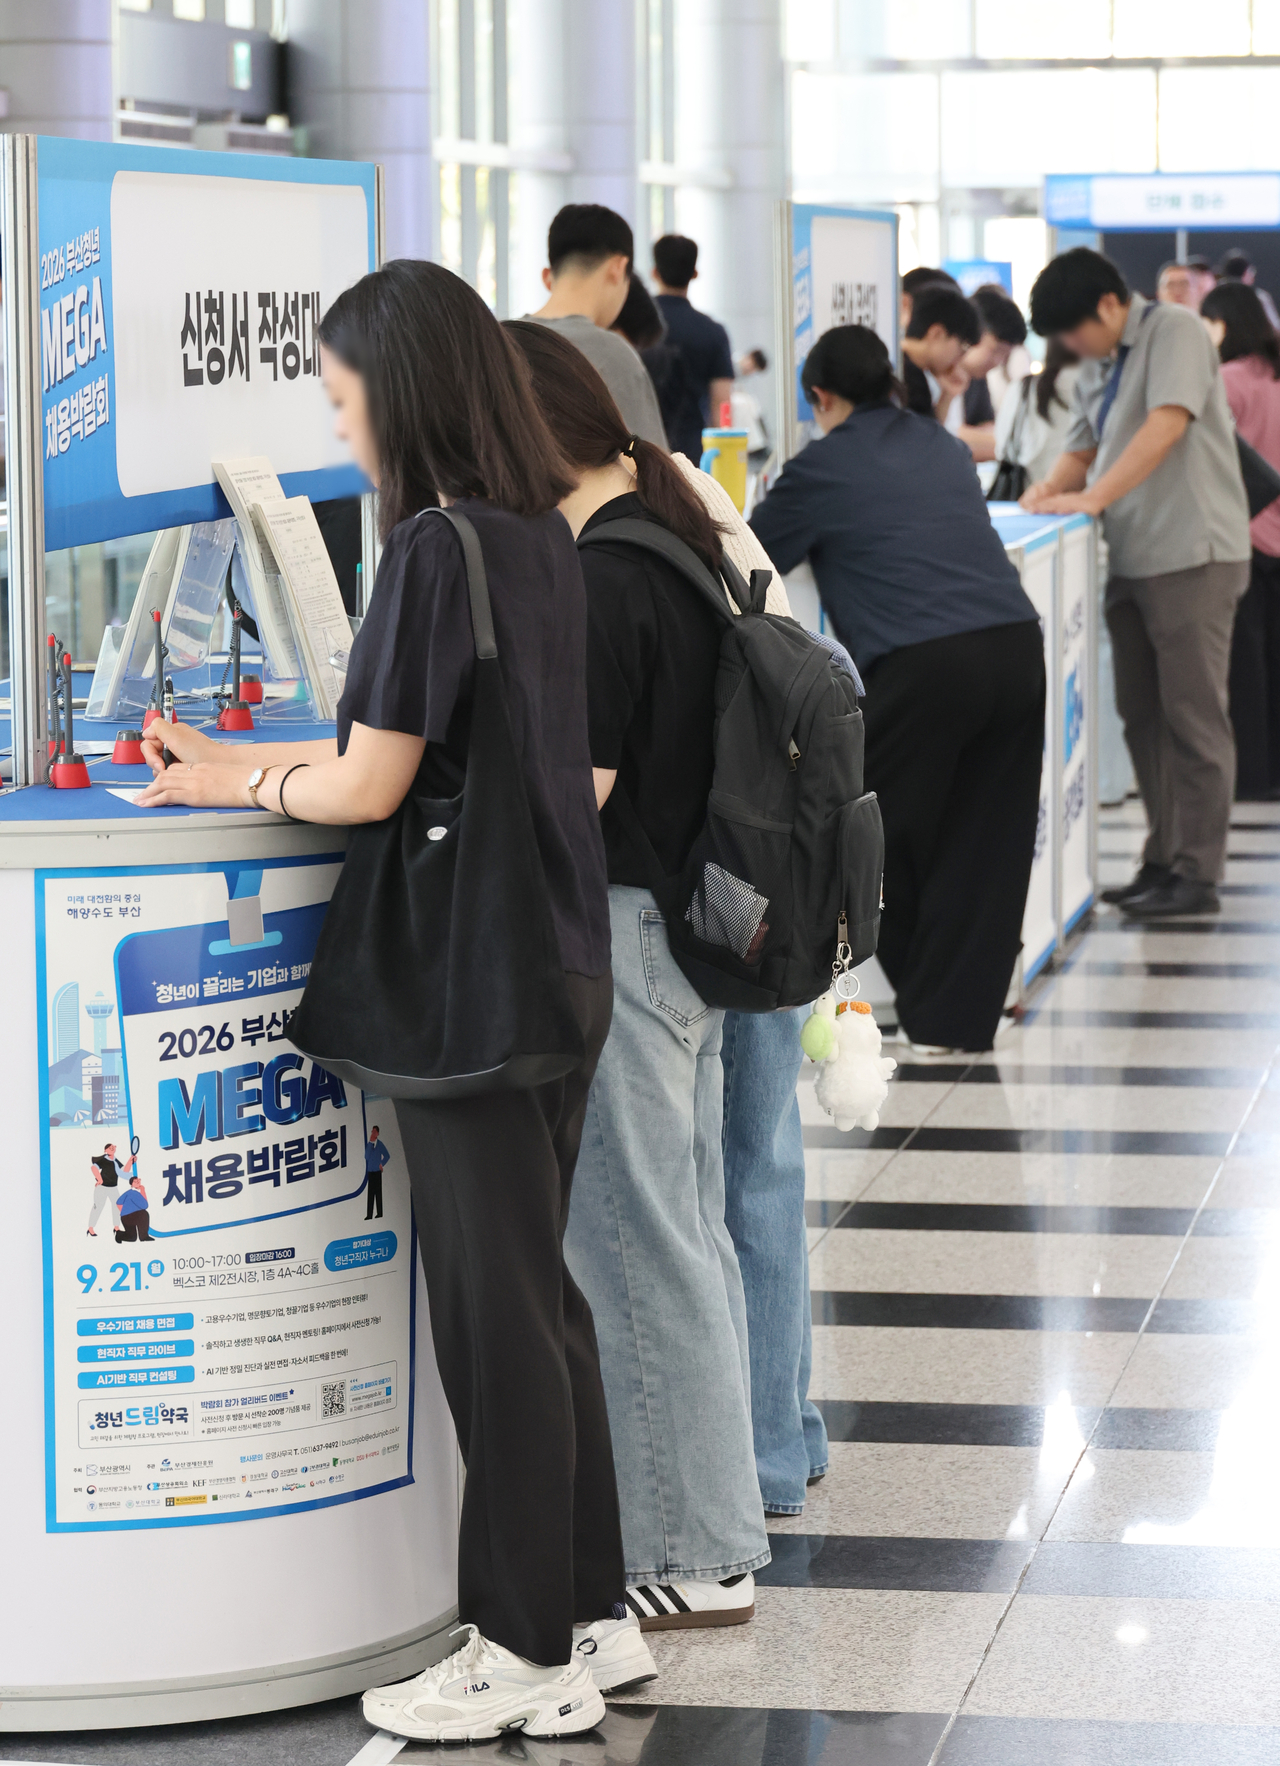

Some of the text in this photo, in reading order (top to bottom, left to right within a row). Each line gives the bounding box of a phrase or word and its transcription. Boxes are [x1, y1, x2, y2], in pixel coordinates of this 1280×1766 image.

[41, 226, 101, 290] 2026 부산청년
[41, 275, 107, 393] MEGA
[181, 289, 321, 387] 신청서 작성대
[45, 373, 109, 460] 채용박람회
[67, 893, 140, 904] 미래 대전환의 중심
[67, 906, 141, 919] 해양수도 부산
[156, 983, 199, 1004] 청년이
[203, 976, 244, 997] 끌리는
[247, 966, 288, 989] 기업과
[158, 1022, 235, 1062] 2026
[158, 1053, 348, 1150] MEGA
[162, 1124, 347, 1207] 채용박람회
[173, 1253, 242, 1270] 10:00~17:00
[249, 1249, 292, 1263] 입장마감 16:00
[334, 1246, 389, 1267] 청년구직자 누구나
[76, 1262, 162, 1293] 9. 21. 월
[173, 1262, 319, 1289] 벡스코 제2전시장, 1층 4A~4C홀
[96, 1317, 175, 1332] 우수기업 채용 면접
[205, 1312, 246, 1324] 고용우수기업,
[205, 1340, 233, 1350] 솔직하고
[234, 1337, 253, 1348] 생생한
[254, 1336, 266, 1345] 직무
[267, 1334, 283, 1344] Q&A,
[284, 1330, 301, 1341] 현직자
[96, 1344, 176, 1359] 현직자 직무 라이브
[96, 1370, 177, 1385] AI기반 직무 컨설팅
[206, 1368, 214, 1376] AI
[214, 1366, 229, 1375] 기반
[230, 1364, 243, 1374] 정밀
[244, 1362, 263, 1373] 진단과
[263, 1360, 276, 1370] 실전
[200, 1391, 288, 1409] 박람회 참가 얼리버드 이벤트
[225, 1414, 231, 1422] 후
[232, 1412, 244, 1421] 방문
[268, 1407, 285, 1416] 200명
[192, 1479, 207, 1487] KEF
